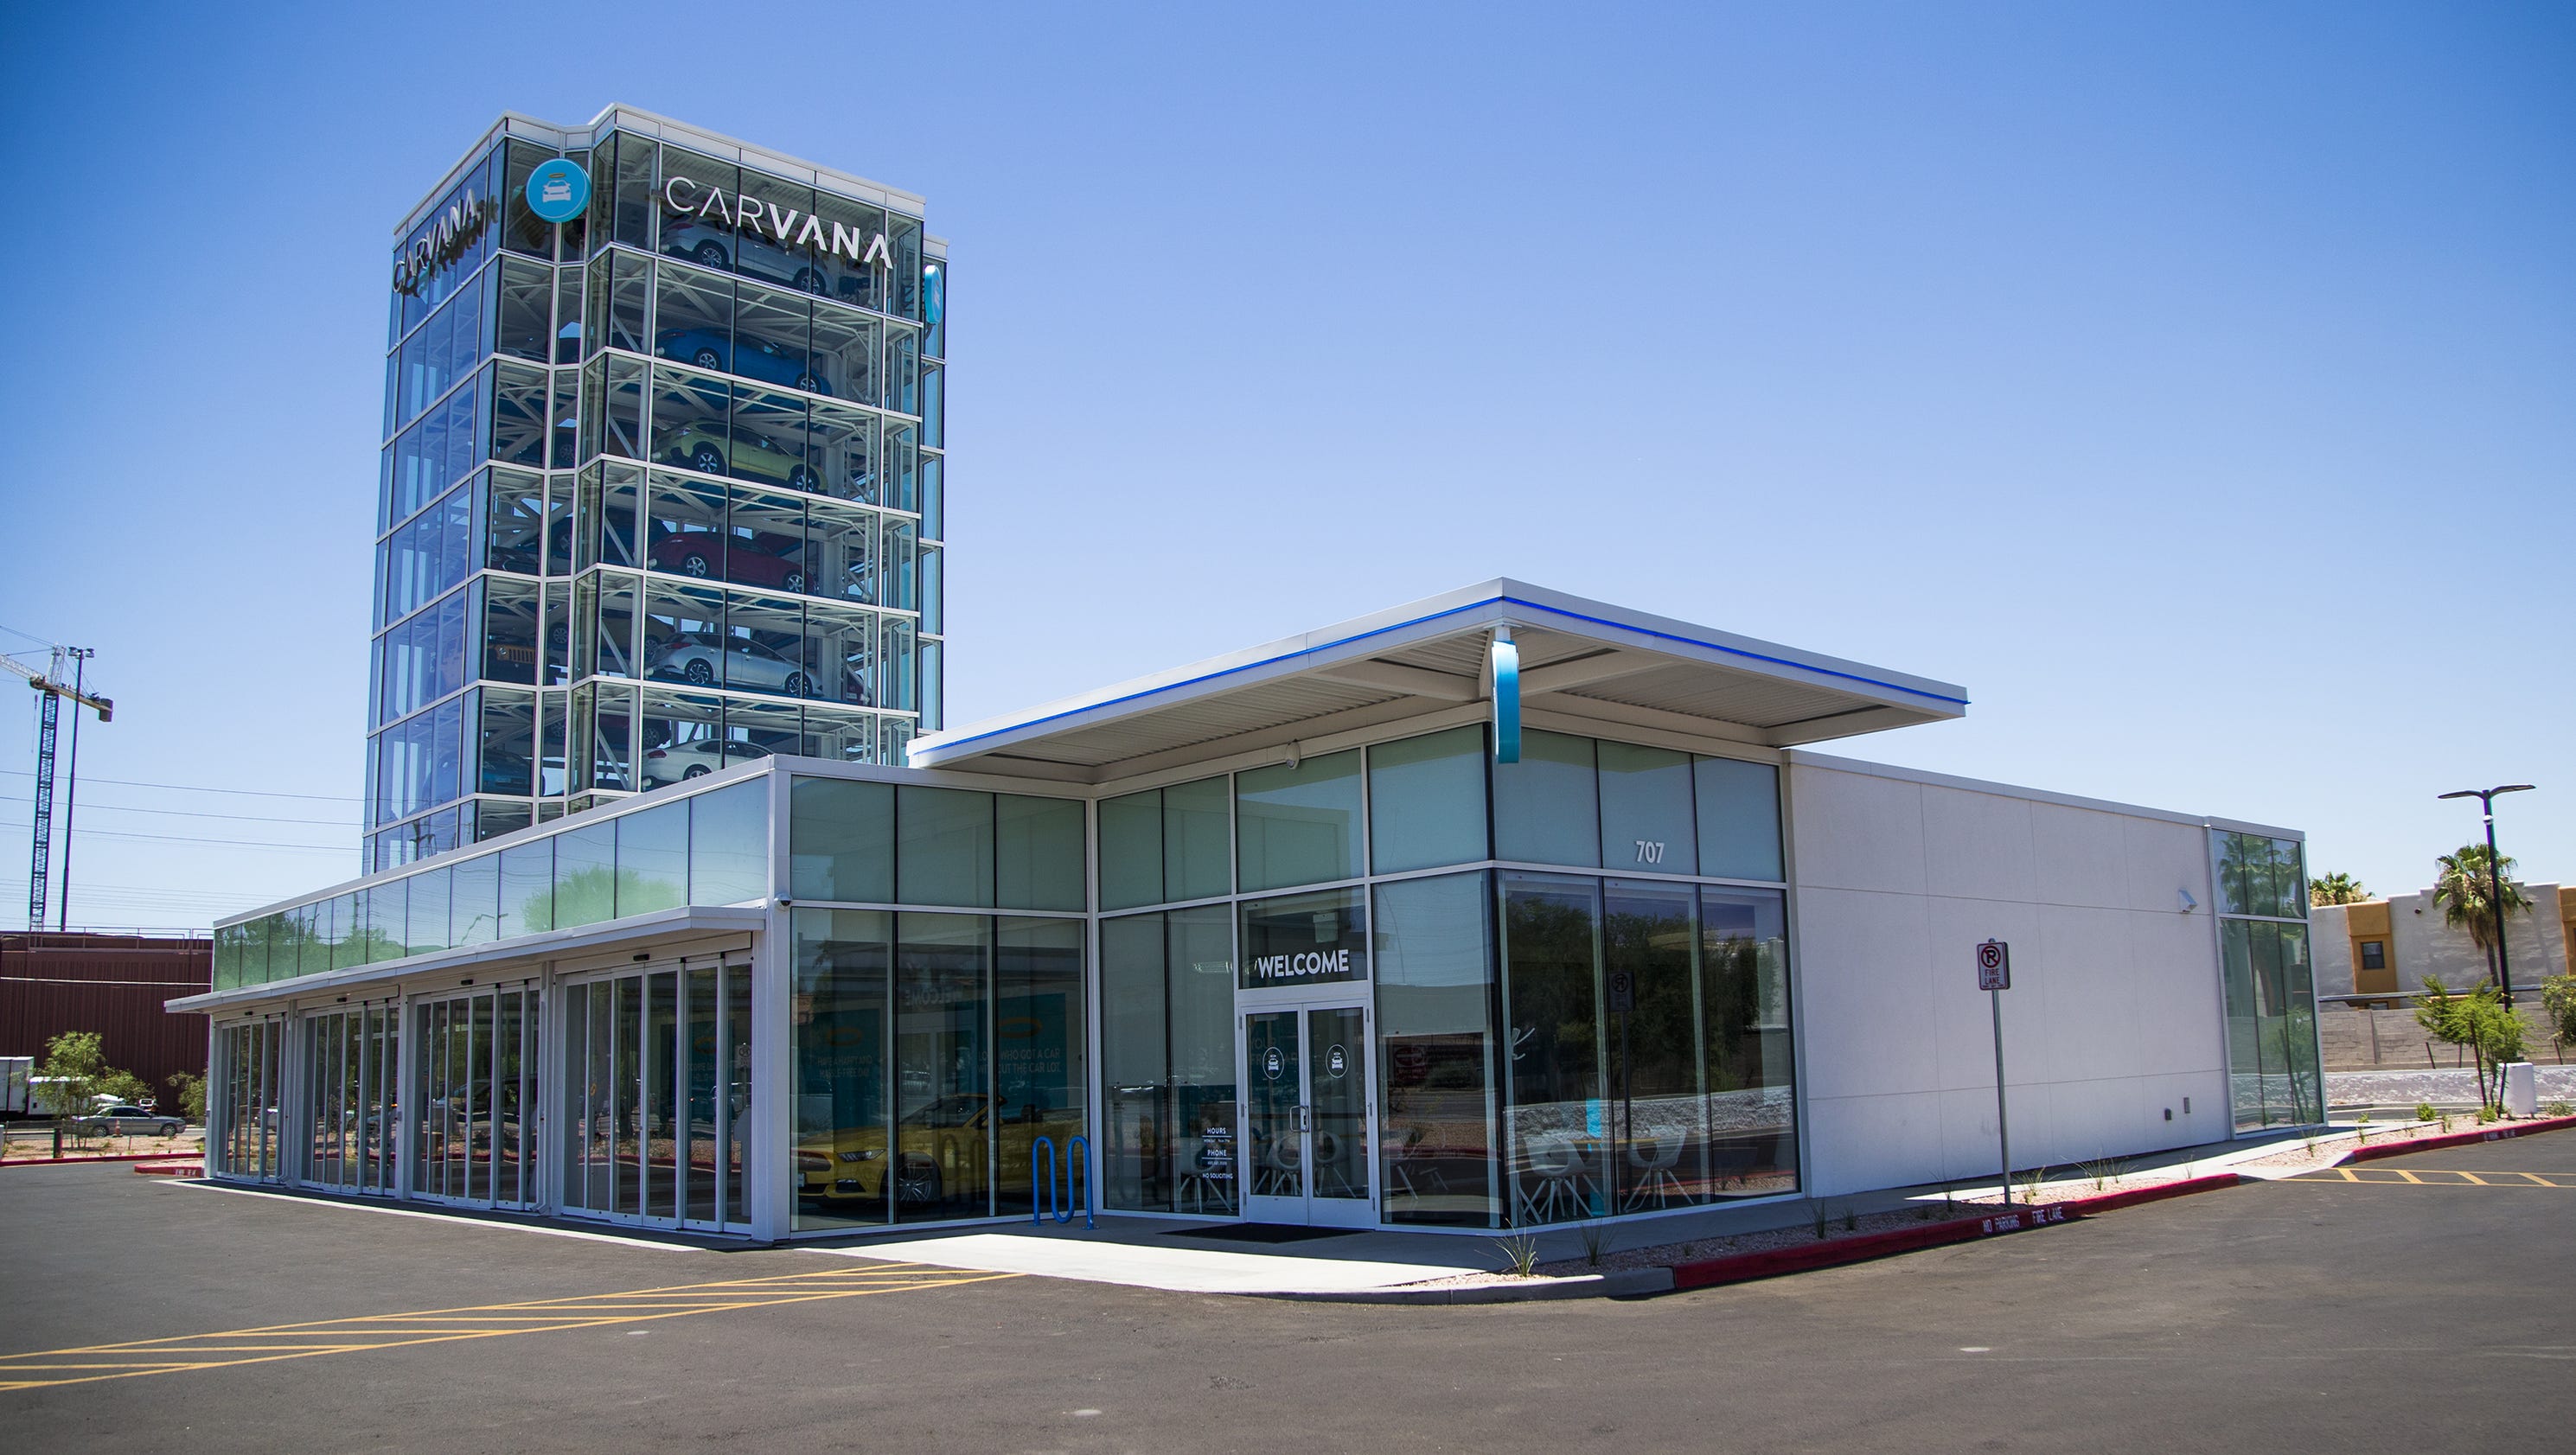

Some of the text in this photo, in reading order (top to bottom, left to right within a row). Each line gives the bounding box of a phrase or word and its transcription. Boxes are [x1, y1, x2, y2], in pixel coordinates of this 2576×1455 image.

[666, 175, 893, 270] CARVANA
[393, 188, 482, 293] CARVANA
[1636, 839, 1665, 864] 707
[1257, 948, 1349, 979] WELCOME
[1020, 1049, 1036, 1060] GOT
[1044, 1047, 1060, 1059] CAR
[1028, 1062, 1045, 1073] CAR
[1982, 1206, 2064, 1233] NO PARKING FIRE LANE
